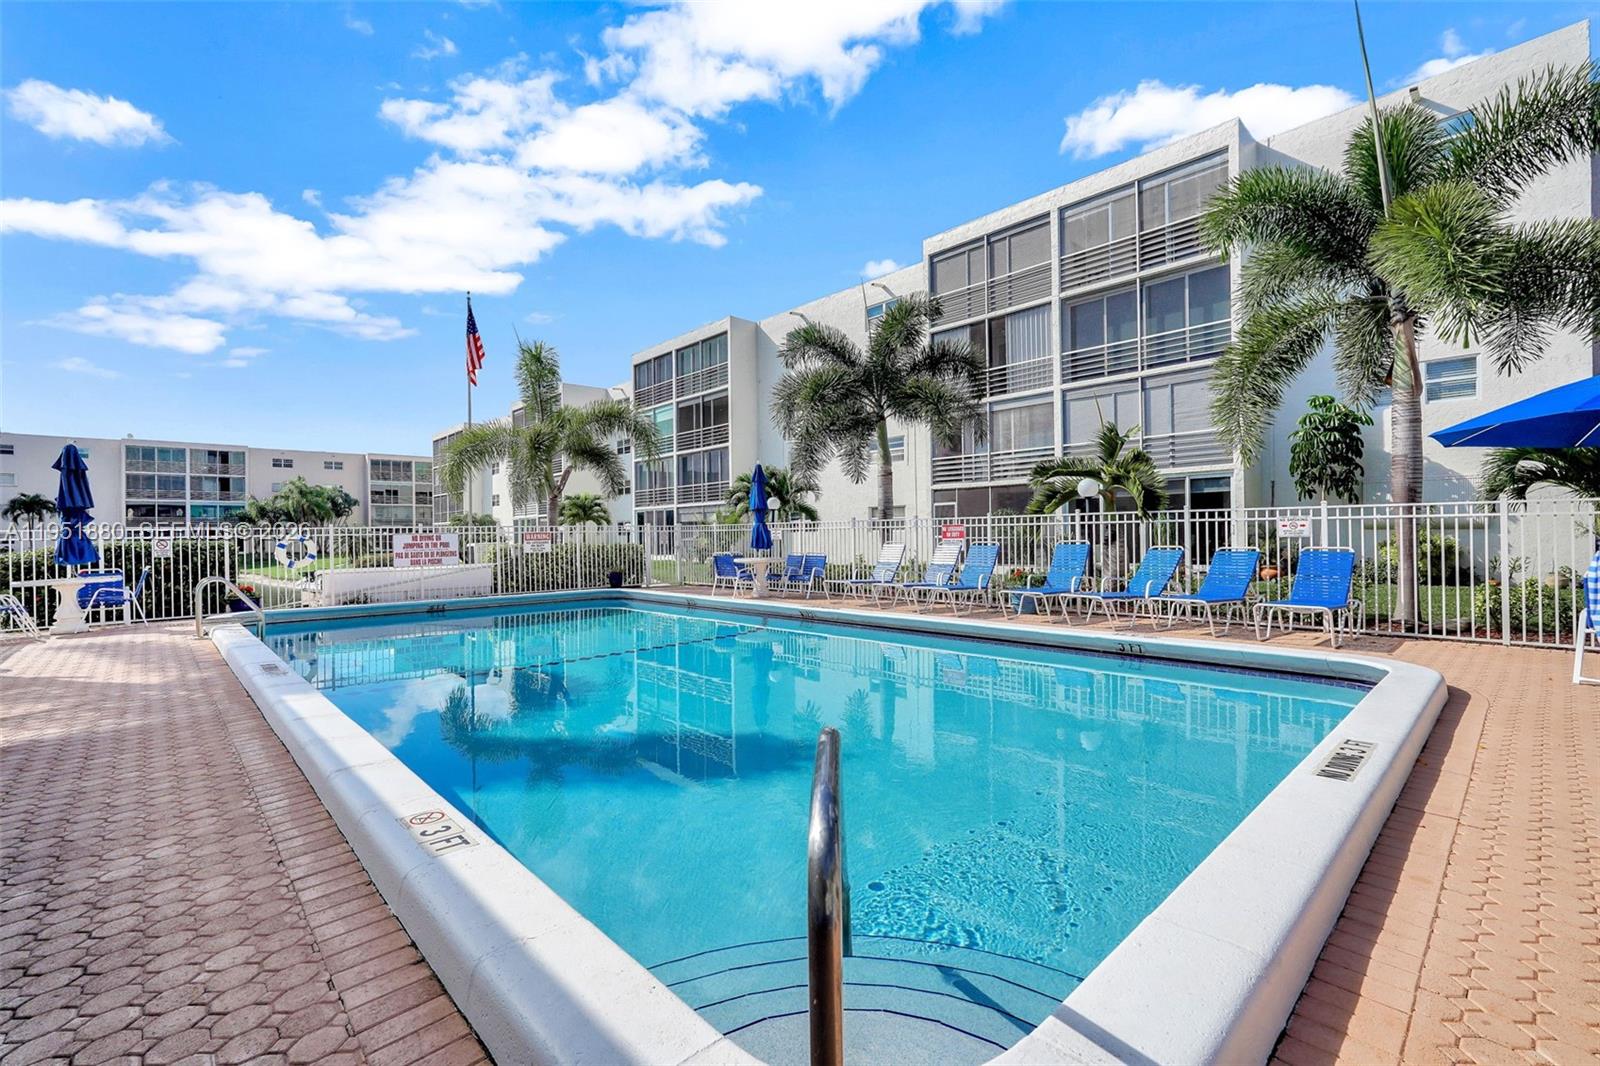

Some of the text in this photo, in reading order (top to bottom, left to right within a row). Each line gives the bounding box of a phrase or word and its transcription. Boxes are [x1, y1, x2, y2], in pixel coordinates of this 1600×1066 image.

[410, 551, 423, 559] SAUTS
[1118, 642, 1143, 653] 3 FT
[1316, 739, 1374, 781] NO DIVING 3 FT
[420, 825, 470, 852] 3 FT
